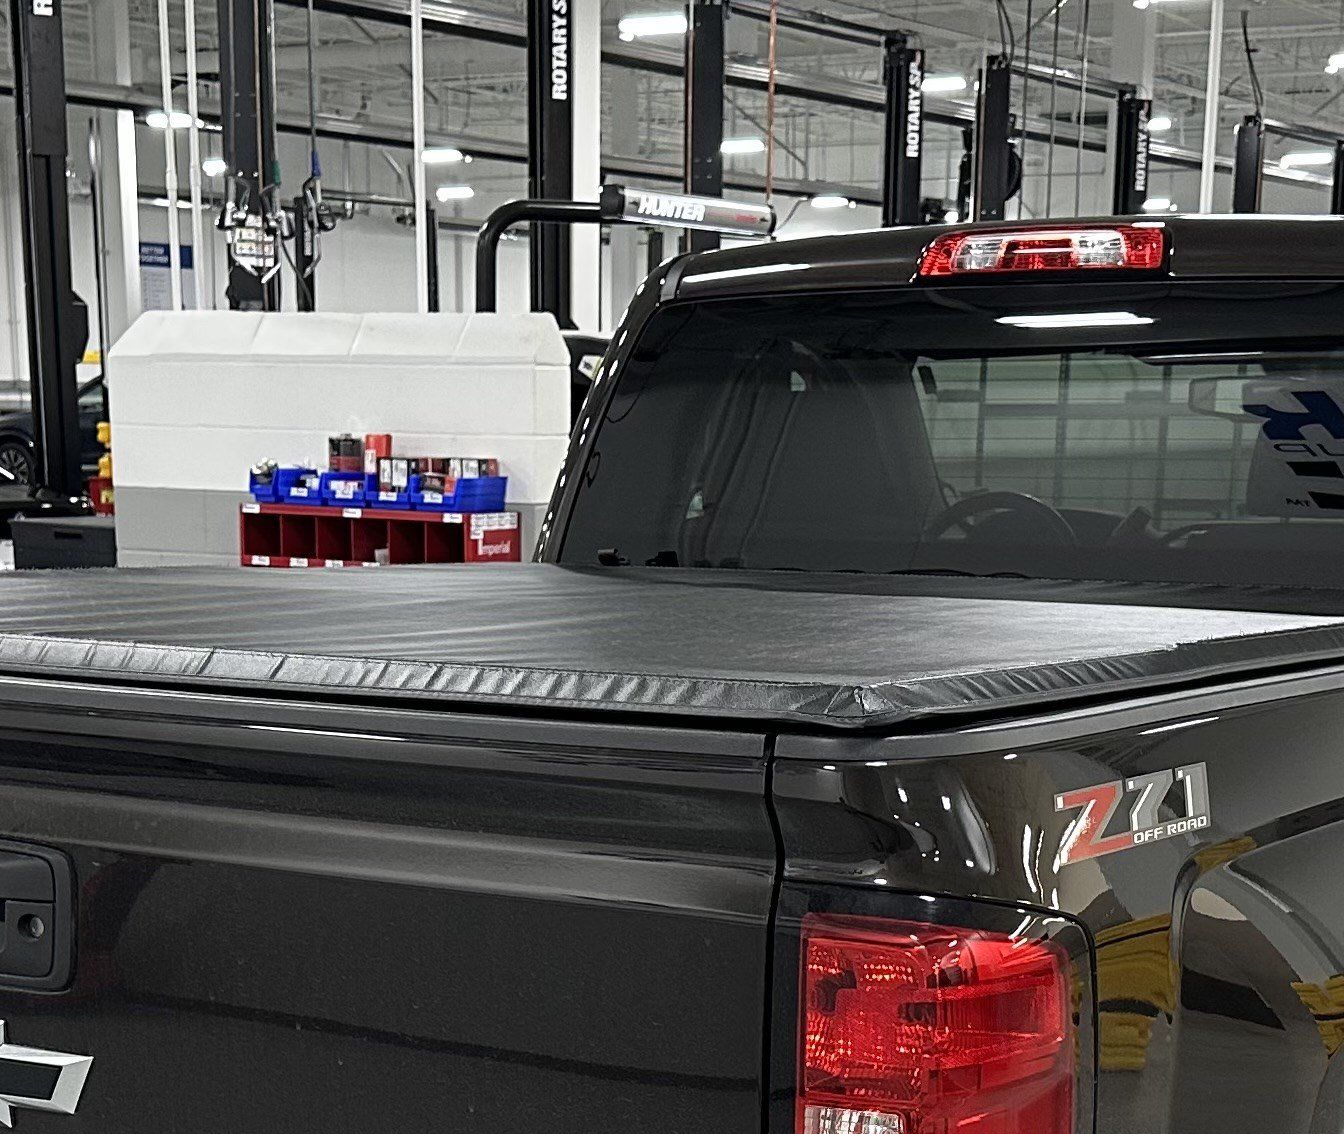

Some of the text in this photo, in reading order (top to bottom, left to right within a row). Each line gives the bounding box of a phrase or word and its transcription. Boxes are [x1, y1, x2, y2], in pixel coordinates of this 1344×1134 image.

[552, 14, 567, 100] ROTARY
[905, 88, 921, 157] ROTARY
[1134, 132, 1147, 191] ROTARY
[637, 194, 705, 222] HUNTER
[1054, 762, 1211, 866] Z71
[1133, 816, 1207, 844] OFF ROAD
